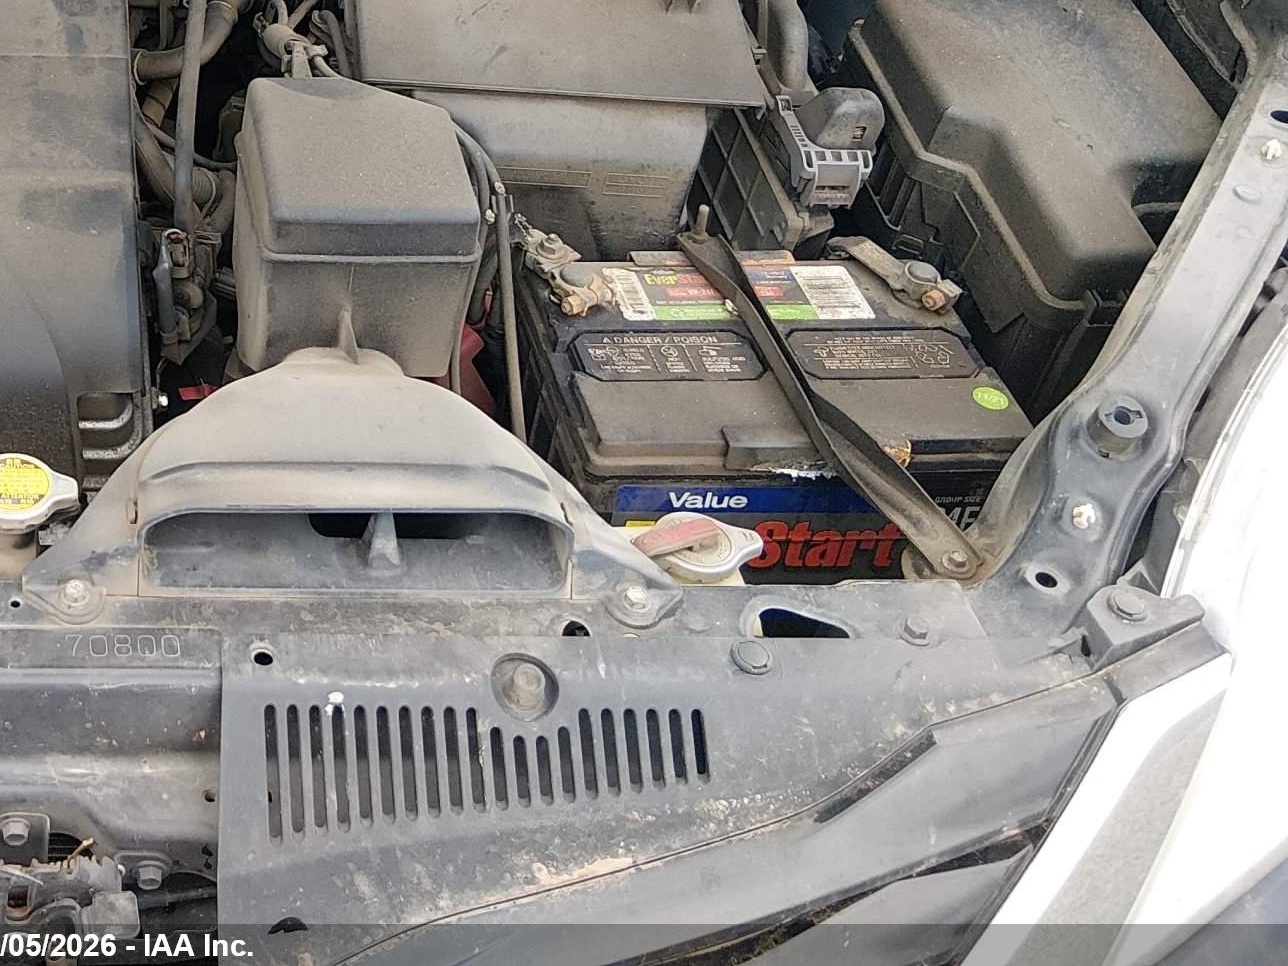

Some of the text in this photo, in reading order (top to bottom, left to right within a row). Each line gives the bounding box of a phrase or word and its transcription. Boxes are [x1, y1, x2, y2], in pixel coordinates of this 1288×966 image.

[614, 336, 662, 344] DANGER
[672, 336, 718, 344] POISON
[669, 492, 748, 509] Value
[934, 495, 982, 504] GROUP SIZE
